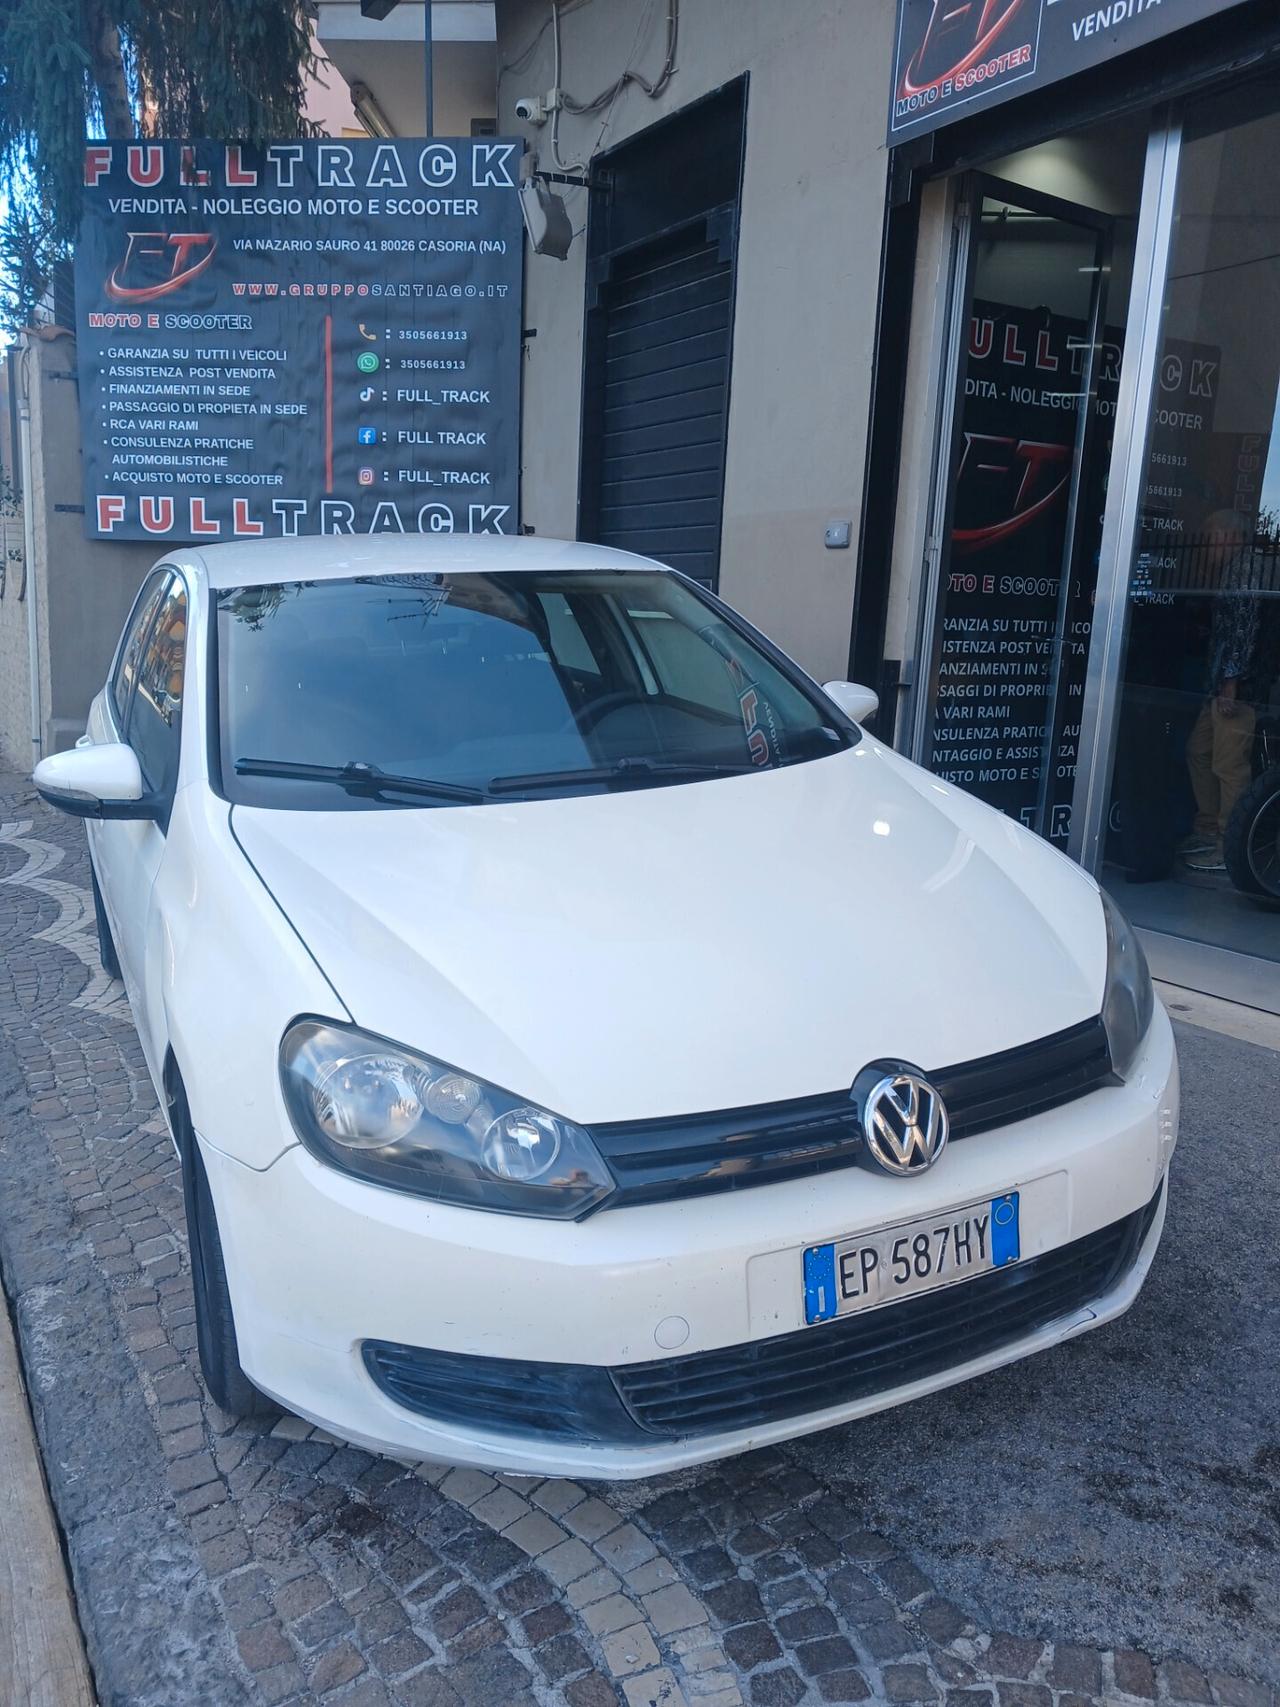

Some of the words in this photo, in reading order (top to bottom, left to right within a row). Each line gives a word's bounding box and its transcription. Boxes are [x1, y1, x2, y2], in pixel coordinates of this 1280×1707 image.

[895, 86, 938, 117] MOTO
[941, 78, 952, 98] E
[955, 44, 1032, 92] SCOOTER
[108, 198, 187, 214] VENDITA
[203, 198, 302, 215] NOLEGGIO
[307, 199, 362, 215] MOTO
[368, 199, 379, 215] E
[385, 199, 479, 216] SCOOTER
[233, 239, 252, 250] VIA
[256, 239, 312, 251] NAZARIO
[316, 240, 360, 251] SAURO
[363, 240, 377, 251] 41
[380, 240, 415, 251] 80026
[418, 240, 476, 252] CASORIA
[479, 240, 506, 254] (NA)
[232, 283, 509, 297] WWW.GRUPPOSANTIAGO.IT
[89, 313, 142, 328] MOTO
[147, 313, 160, 328] E
[165, 314, 253, 330] SCOOTER
[398, 330, 468, 340] 3505661913
[107, 347, 169, 359] GARANZIA
[172, 348, 189, 360] SU
[195, 349, 229, 360] TUTTI
[232, 350, 236, 360] I
[239, 350, 287, 361] VEICOLI
[400, 359, 466, 370] 3505661913
[108, 366, 183, 377] ASSISTENZA
[189, 367, 220, 378] POST
[225, 368, 276, 379] VENDITA
[109, 383, 200, 395] FINANZIAMENTI
[203, 385, 215, 395] IN
[218, 385, 251, 396] SEDE
[965, 378, 998, 400] DITA
[1010, 385, 1080, 411] NOLEGGI
[397, 389, 491, 405] FULL_TRACK
[109, 401, 180, 413] PASSAGGIO
[183, 403, 195, 413] DI
[198, 403, 257, 414] PROPIETA
[260, 404, 271, 414] IN
[275, 404, 308, 415] SEDE
[110, 419, 136, 430] RCA
[139, 420, 165, 430] VARI
[168, 420, 199, 431] RAMI
[111, 436, 191, 448] CONSULENZA
[194, 438, 254, 449] PRATICHE
[398, 431, 433, 444] FULL
[437, 432, 487, 445] TRACK
[112, 454, 228, 466] AUTOMOBILISTICHE
[112, 471, 173, 483] ACQUISTO
[176, 473, 211, 483] MOTO
[214, 473, 222, 484] E
[225, 474, 283, 485] SCOOTER
[398, 470, 491, 486] FULL_TRACK
[96, 495, 510, 536] FULLTRACK
[982, 575, 995, 593] E
[992, 619, 1009, 632] SU
[1013, 620, 1048, 633] TUTTI
[999, 641, 1032, 654] POST
[1024, 663, 1038, 676] IN
[983, 684, 997, 697] DI
[943, 706, 974, 719] VARI
[977, 705, 1011, 719] RAMI
[996, 747, 1004, 760] E
[978, 767, 1017, 782] MOTO
[1020, 767, 1029, 780] E
[838, 1247, 878, 1300] EP
[891, 1214, 990, 1285] 587HY
